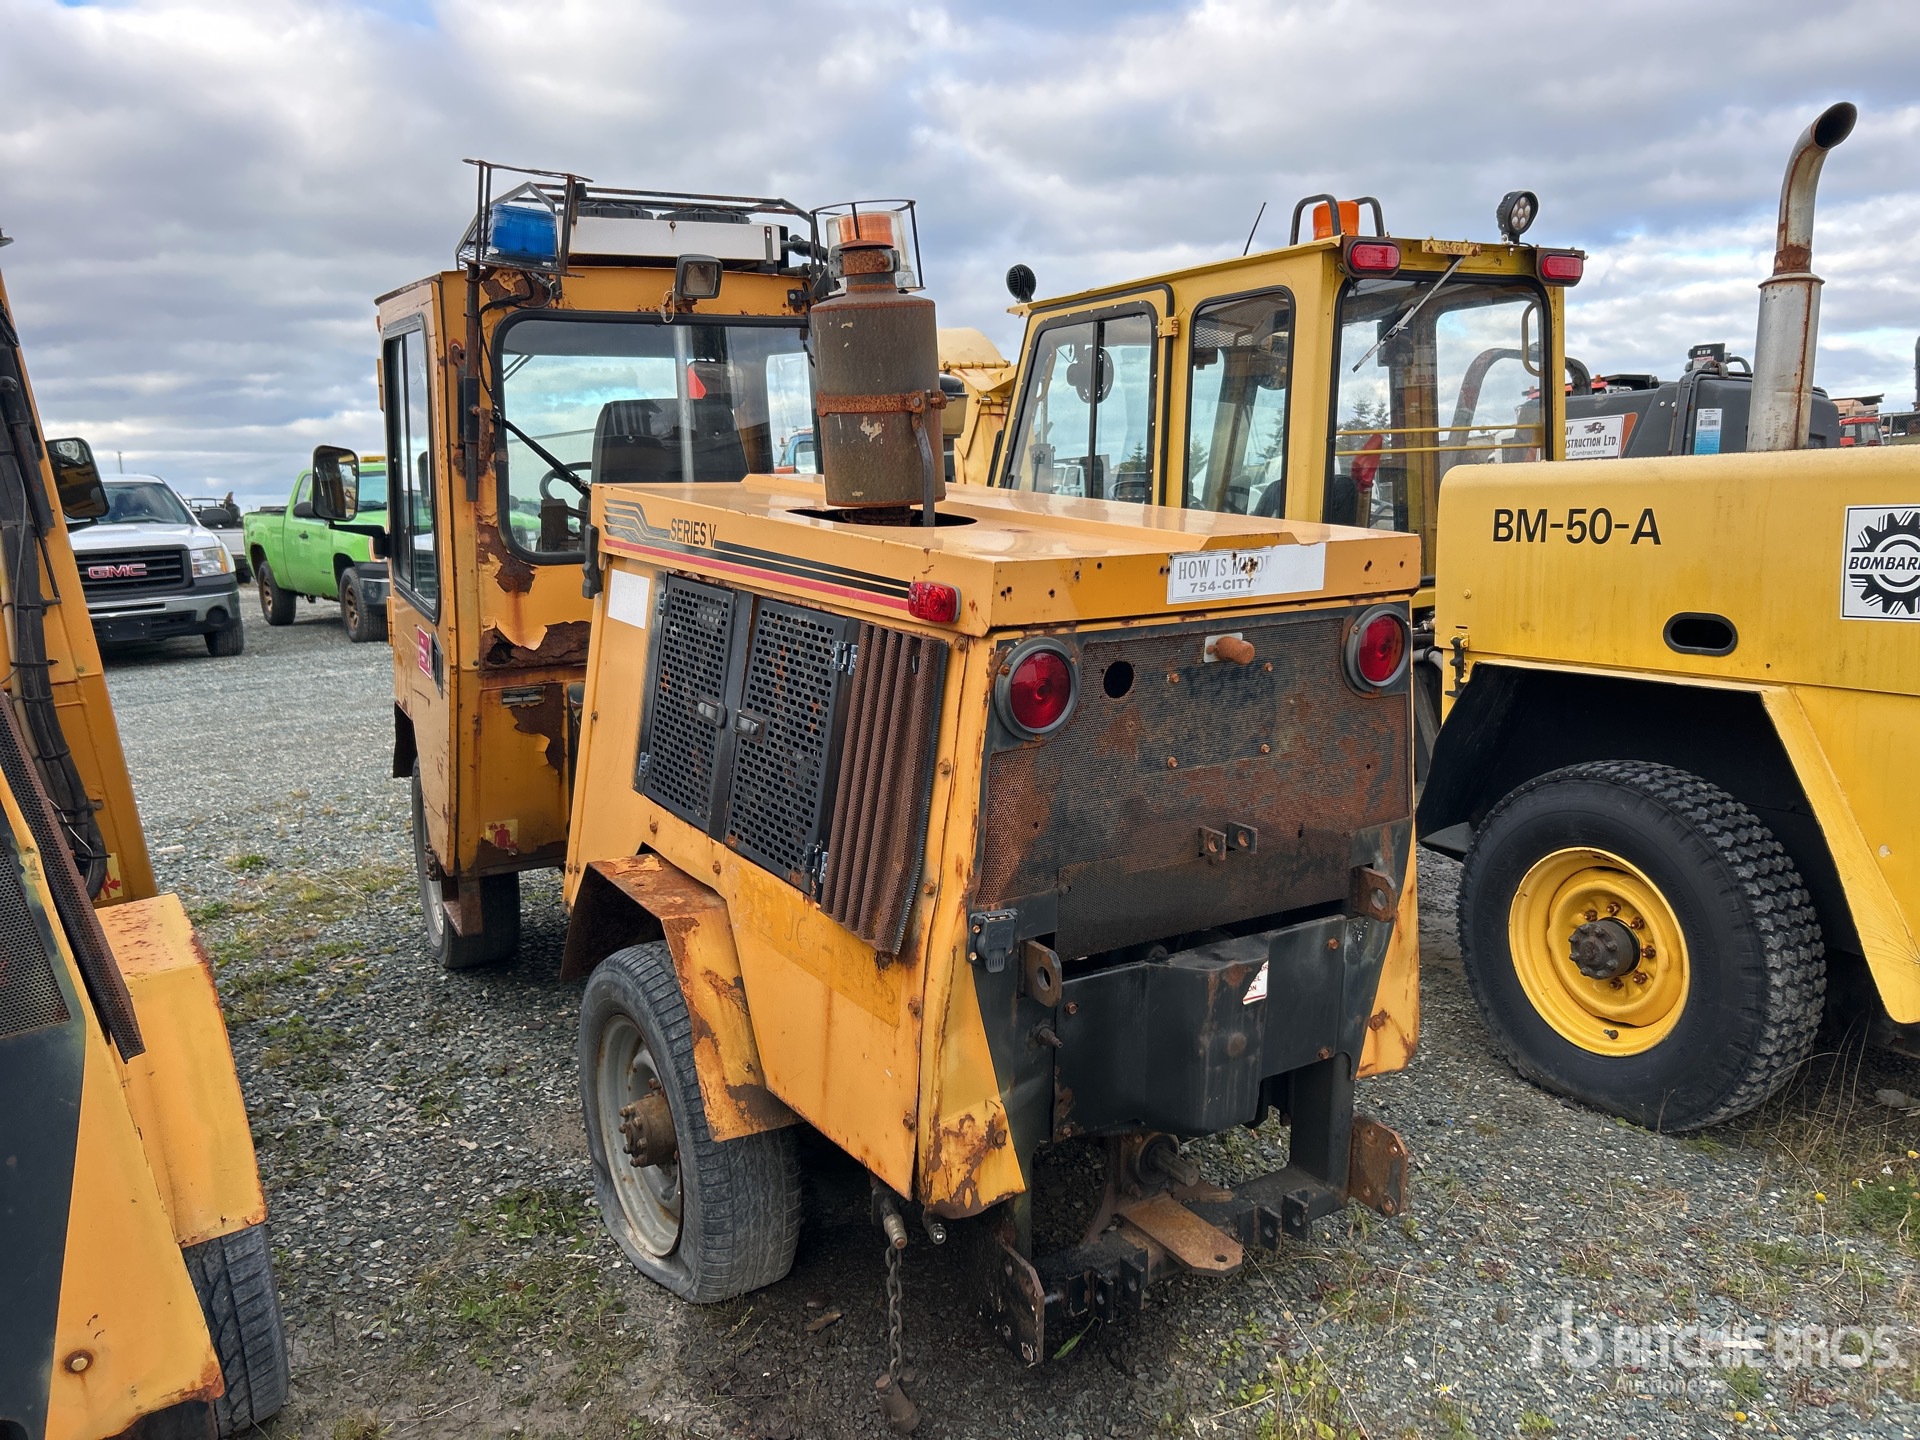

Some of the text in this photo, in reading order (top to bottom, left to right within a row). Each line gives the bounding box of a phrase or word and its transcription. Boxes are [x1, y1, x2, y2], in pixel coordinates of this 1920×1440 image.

[670, 517, 717, 548] SERIES V
[1492, 507, 1662, 546] BM-50-A
[88, 563, 148, 580] GMC
[1179, 560, 1210, 579] HOW
[1215, 558, 1227, 577] IS
[1848, 556, 1920, 570] BOMBAR
[1190, 578, 1253, 593] 754-CITY
